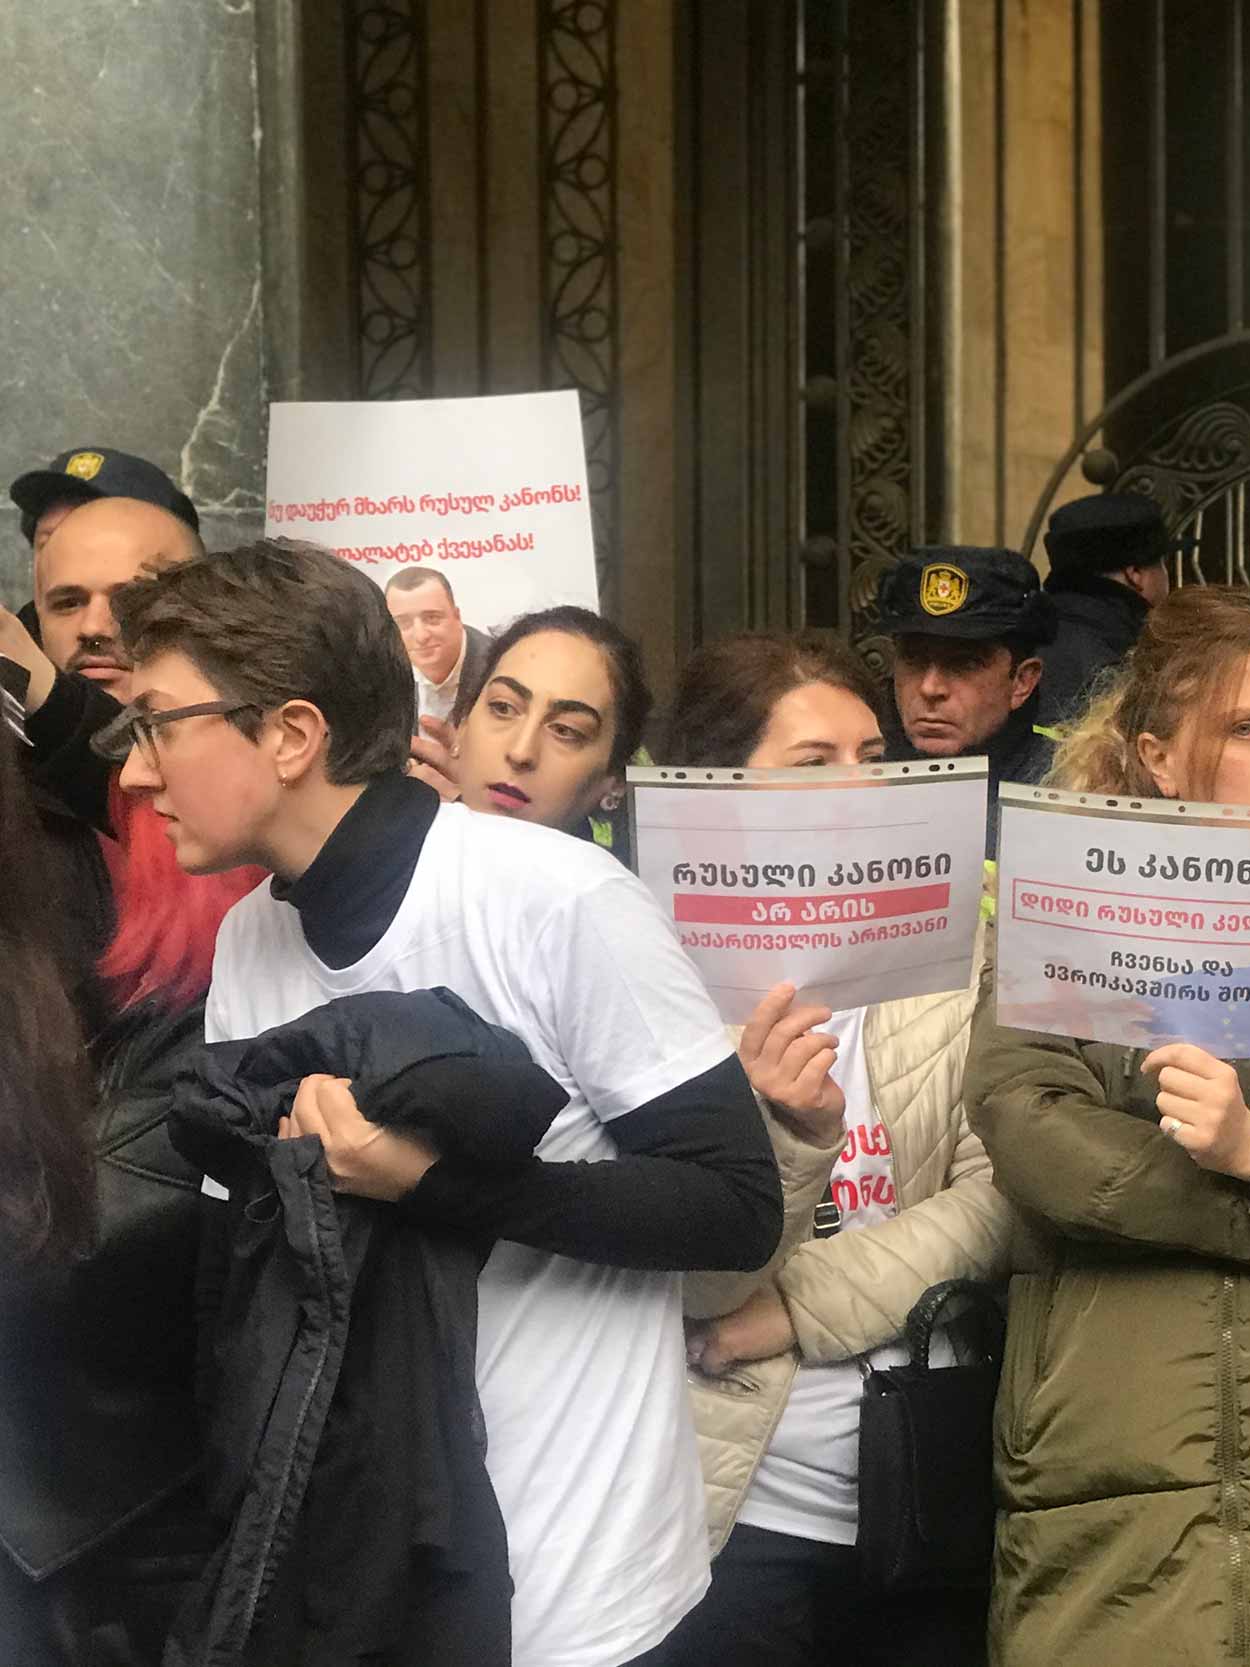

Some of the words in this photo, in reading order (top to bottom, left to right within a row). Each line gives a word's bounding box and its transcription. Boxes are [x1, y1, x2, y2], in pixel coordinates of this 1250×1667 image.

[354, 495, 415, 516] მხარს
[420, 492, 494, 515] რუსულ
[500, 484, 581, 512] კანონს!
[438, 533, 534, 559] ქვეყანას!
[673, 863, 815, 888] რუსული
[828, 853, 951, 886] კანონი
[1086, 847, 1126, 875] ეს
[752, 902, 791, 922] არ
[802, 899, 875, 922] არის
[1021, 892, 1089, 917] დიდი
[1098, 904, 1205, 930] რუსული
[848, 917, 947, 945] არჩევანი
[1111, 951, 1194, 975] ჩვენსა
[1202, 959, 1233, 977] და
[1044, 963, 1210, 1002] ევროკავშირს
